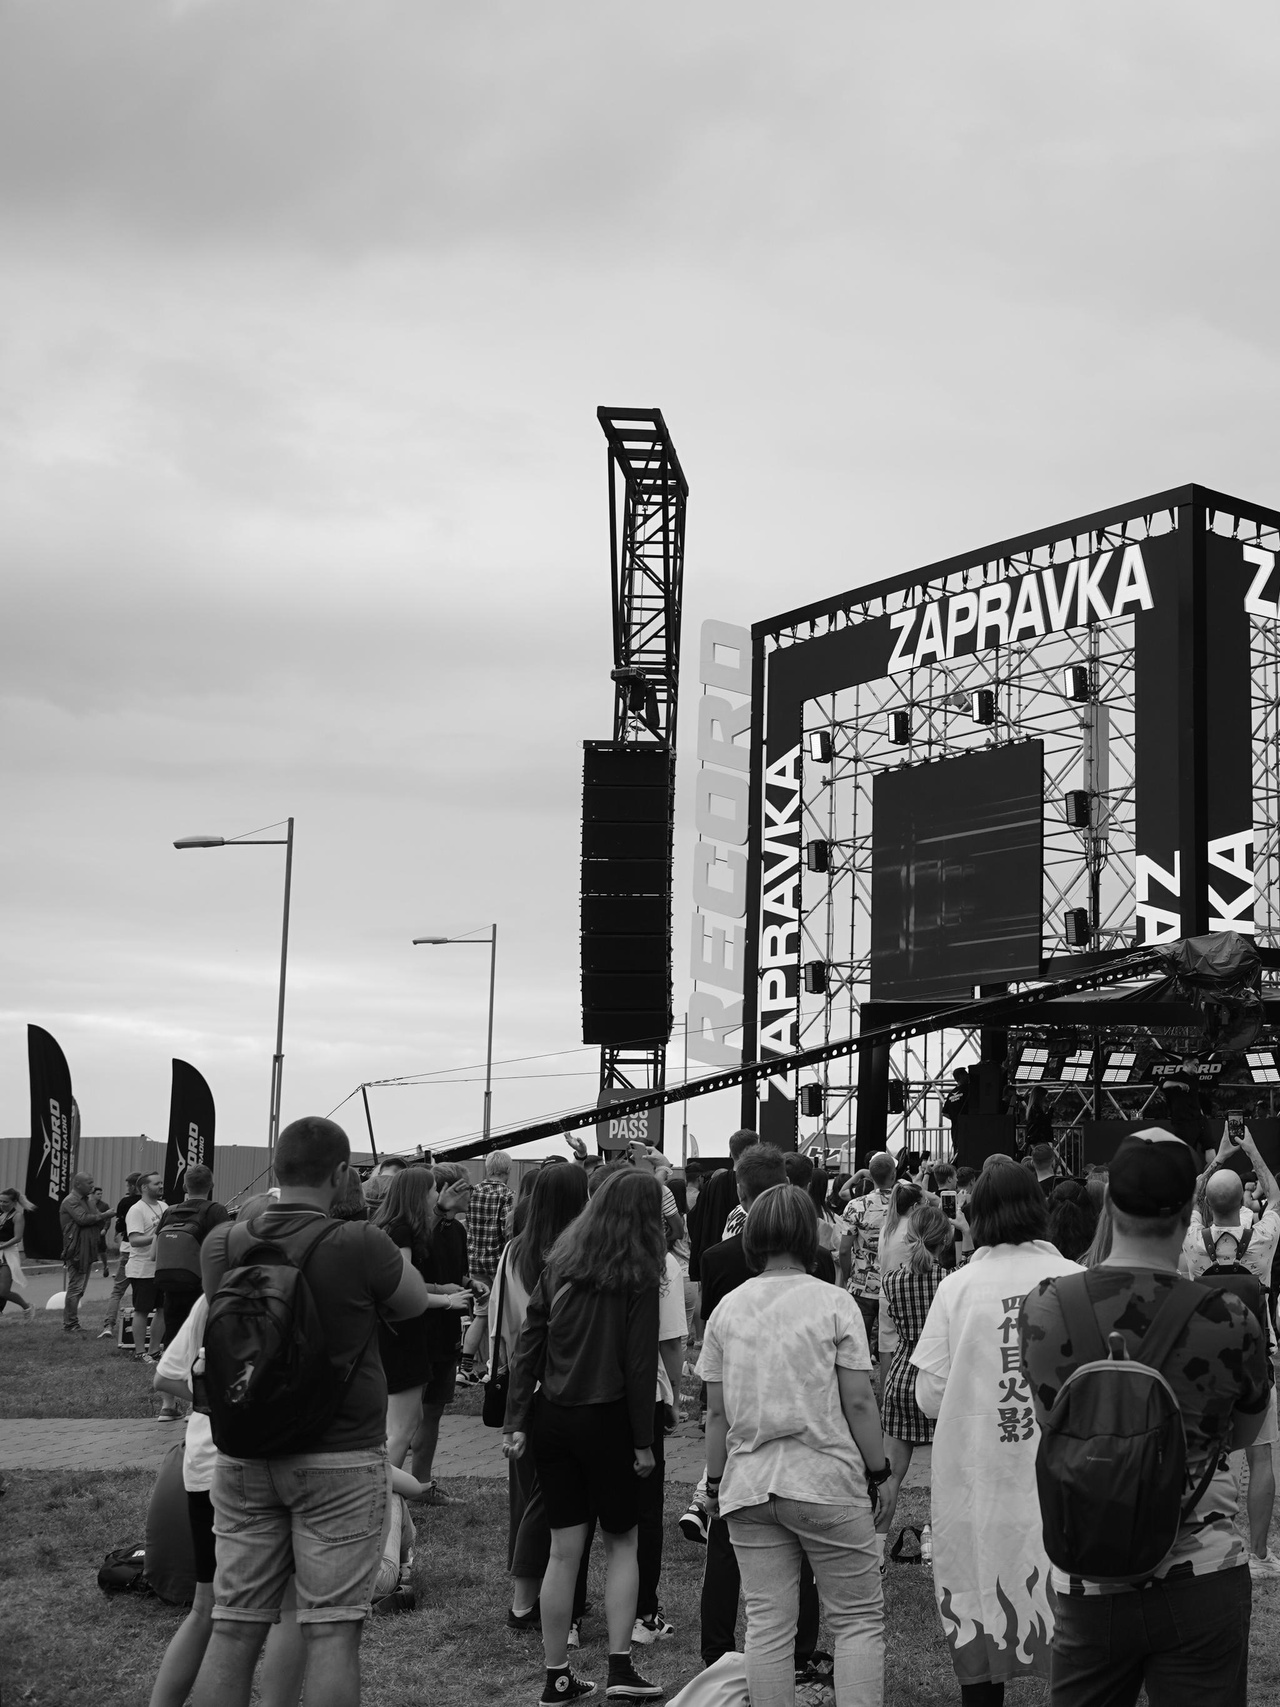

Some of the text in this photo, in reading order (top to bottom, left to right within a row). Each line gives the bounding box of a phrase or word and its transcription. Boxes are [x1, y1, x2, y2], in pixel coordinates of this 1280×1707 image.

[887, 543, 1154, 676] ZAPRAVKA
[686, 618, 752, 1069] RECORD
[760, 743, 800, 1102] ZAPRAVKA
[1152, 1064, 1222, 1075] RERD
[49, 1098, 61, 1201] RECORD
[609, 1120, 648, 1138] PASS
